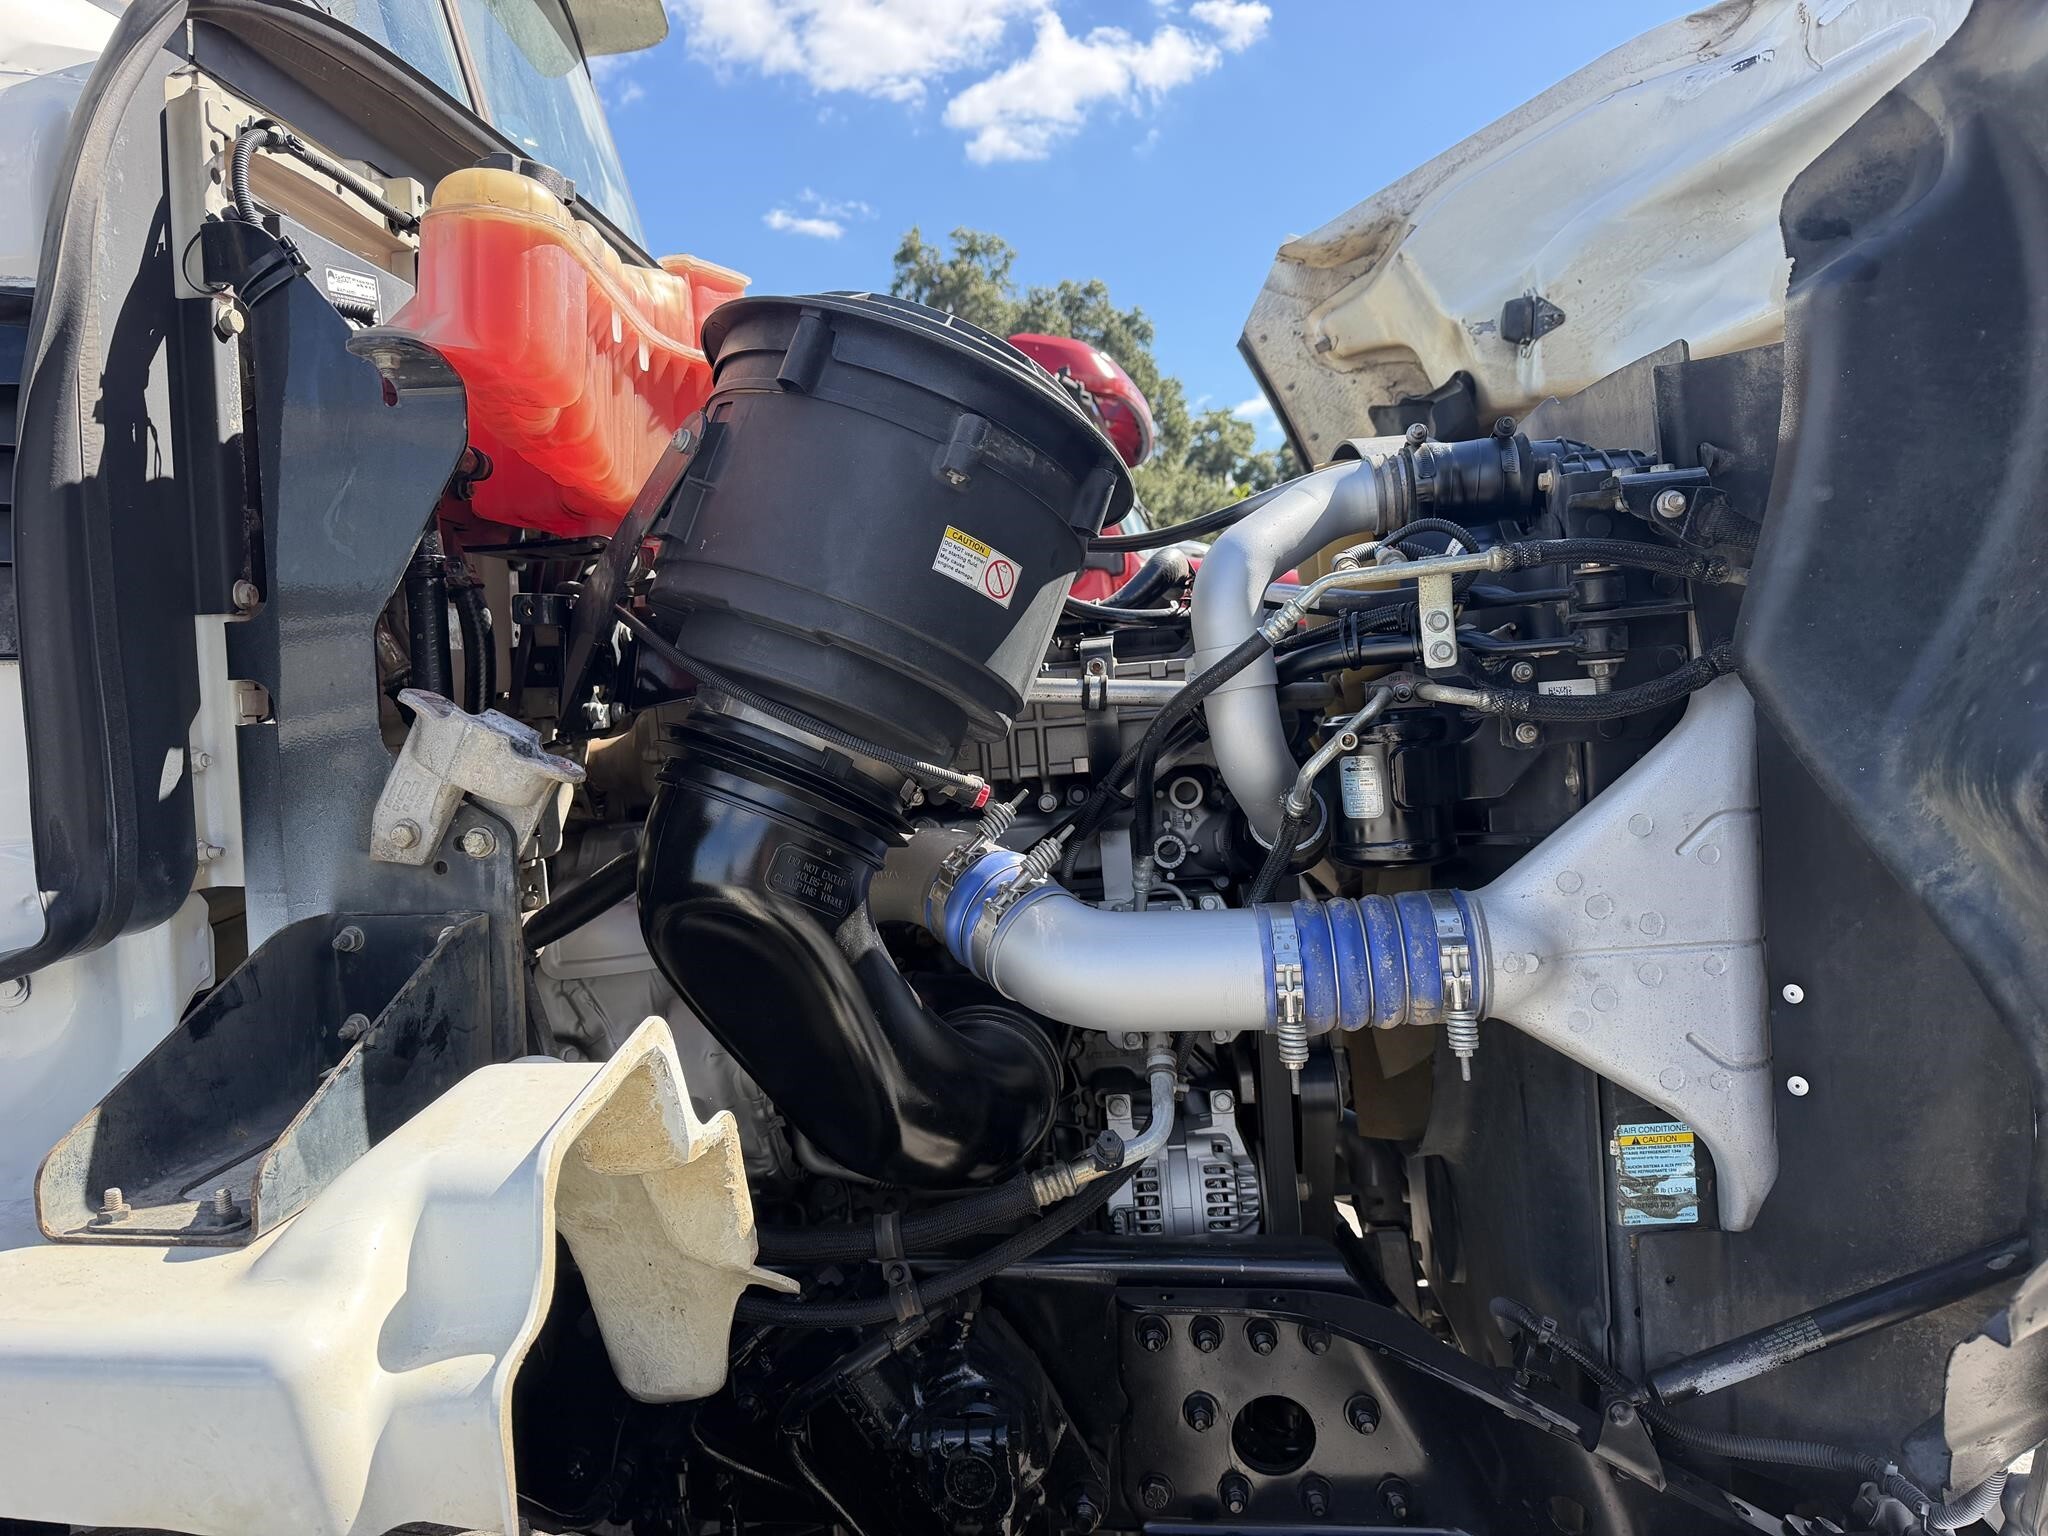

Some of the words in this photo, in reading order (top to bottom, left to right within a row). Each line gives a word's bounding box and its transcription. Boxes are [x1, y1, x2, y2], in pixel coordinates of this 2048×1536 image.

[952, 532, 986, 553] CAUTION
[954, 544, 964, 554] NOT
[940, 553, 950, 562] May
[951, 559, 965, 568] cause
[948, 550, 967, 563] starting
[938, 560, 954, 570] engine
[803, 863, 819, 875] NOT
